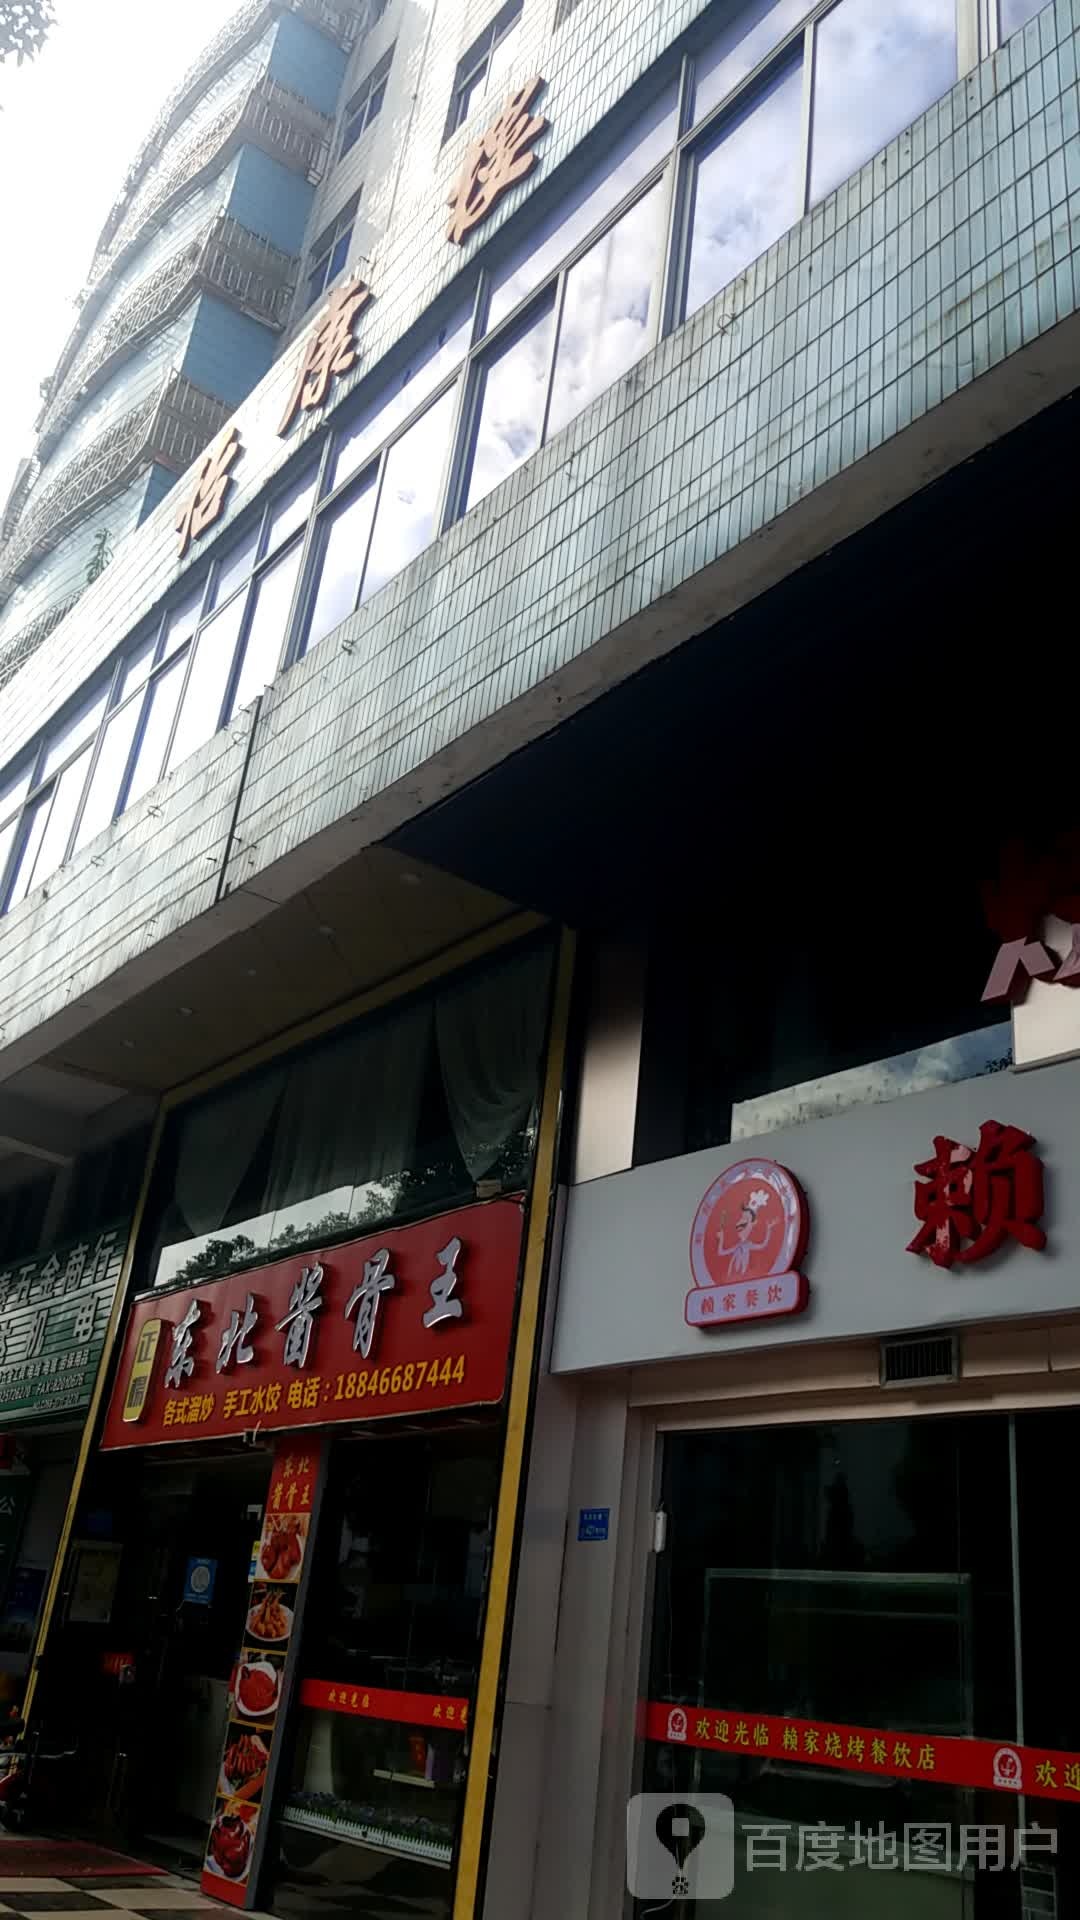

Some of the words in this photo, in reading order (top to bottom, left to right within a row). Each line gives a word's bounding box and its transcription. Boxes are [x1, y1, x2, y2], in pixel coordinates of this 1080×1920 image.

[906, 1119, 1046, 1268] 赖
[223, 1383, 281, 1418] 手工水饺
[695, 1716, 769, 1747] 欢迎光临
[783, 1727, 936, 1771] 赖家烧烤餐饮店
